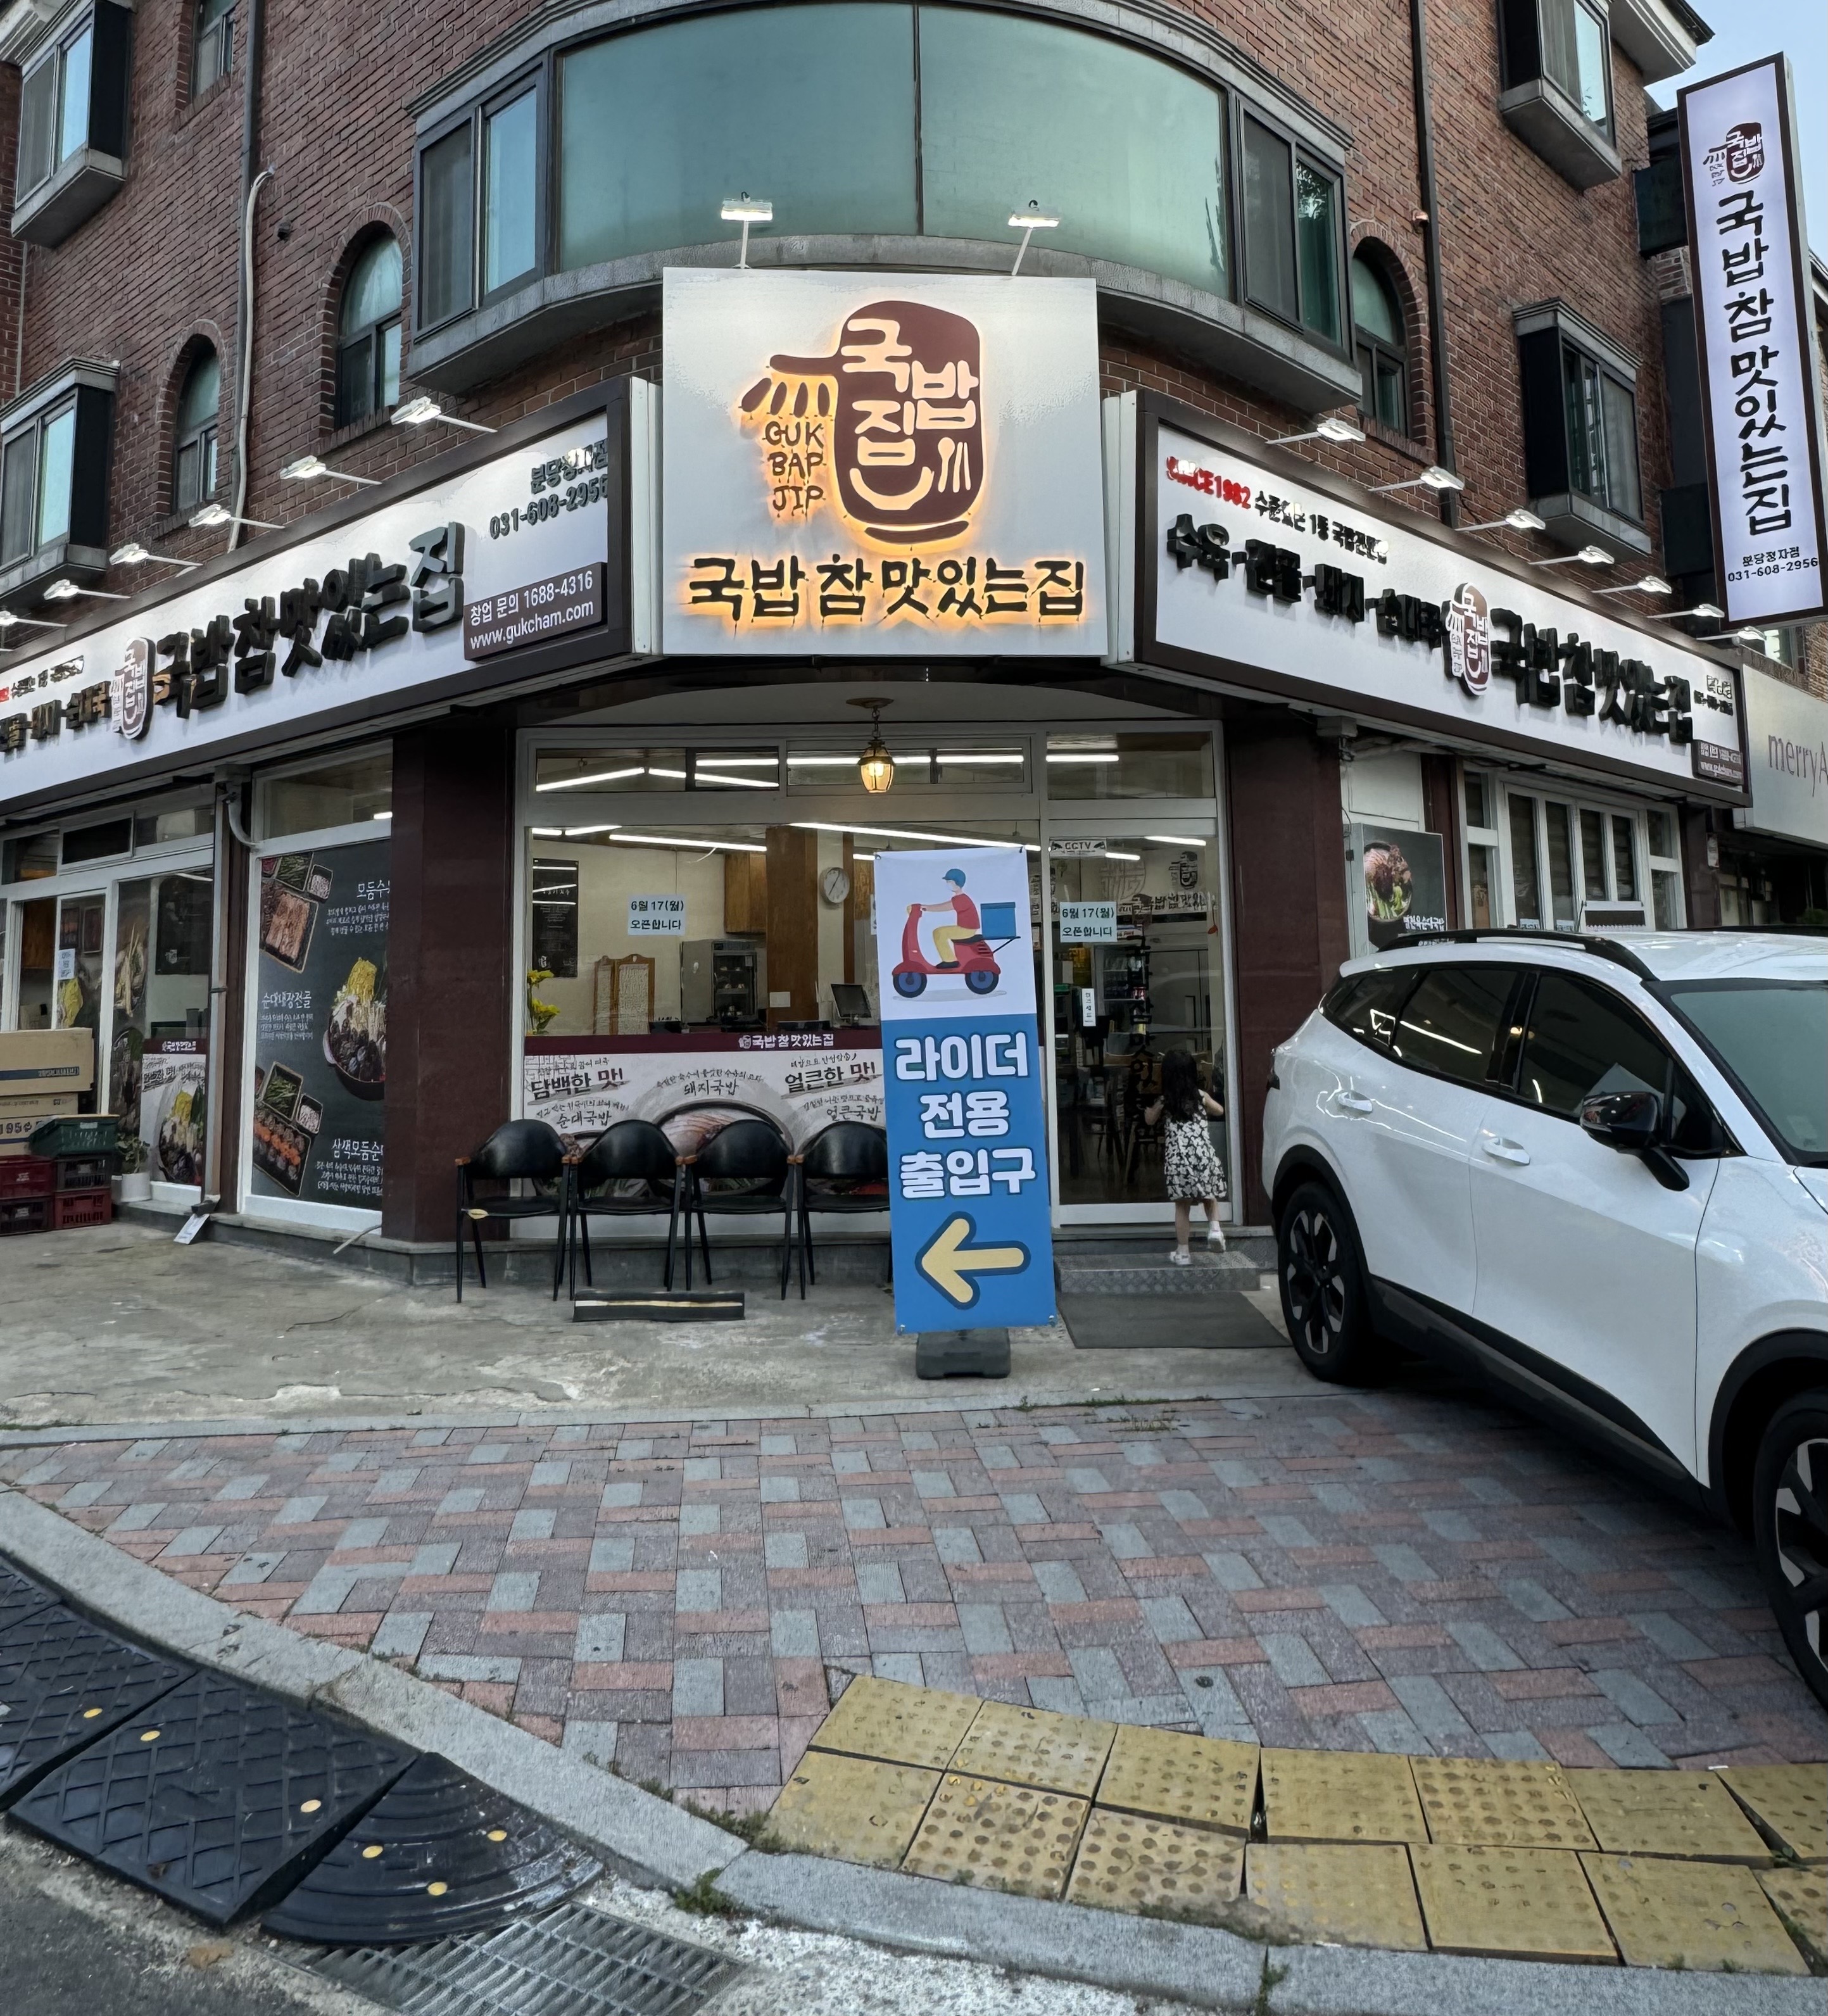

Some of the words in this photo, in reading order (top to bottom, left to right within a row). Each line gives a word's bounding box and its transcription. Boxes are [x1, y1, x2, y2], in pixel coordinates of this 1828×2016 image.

[841, 318, 980, 467] 국밥집
[762, 421, 824, 448] GUK
[531, 438, 608, 495] 분당정점
[768, 452, 825, 479] BAP
[489, 474, 608, 539] 031-608-2956
[771, 485, 825, 513] JIP
[1727, 557, 1819, 582] 031-608-2956
[470, 600, 492, 626] 창업
[496, 593, 519, 619] 문의
[523, 570, 593, 611] 1688-4316
[817, 553, 873, 617] 참
[470, 600, 594, 650] www.gukcham.com
[1065, 841, 1092, 850] CCTV
[895, 1031, 1028, 1082] 라이더
[531, 1072, 592, 1100] 담백한
[684, 1078, 740, 1096] 돼지국밥
[785, 1066, 845, 1093] 얼큰한
[556, 1110, 612, 1129] 순대국밥
[826, 1105, 881, 1121] 얼큰국밥
[919, 1089, 1011, 1139] 전용
[898, 1147, 1038, 1202] 출입구
